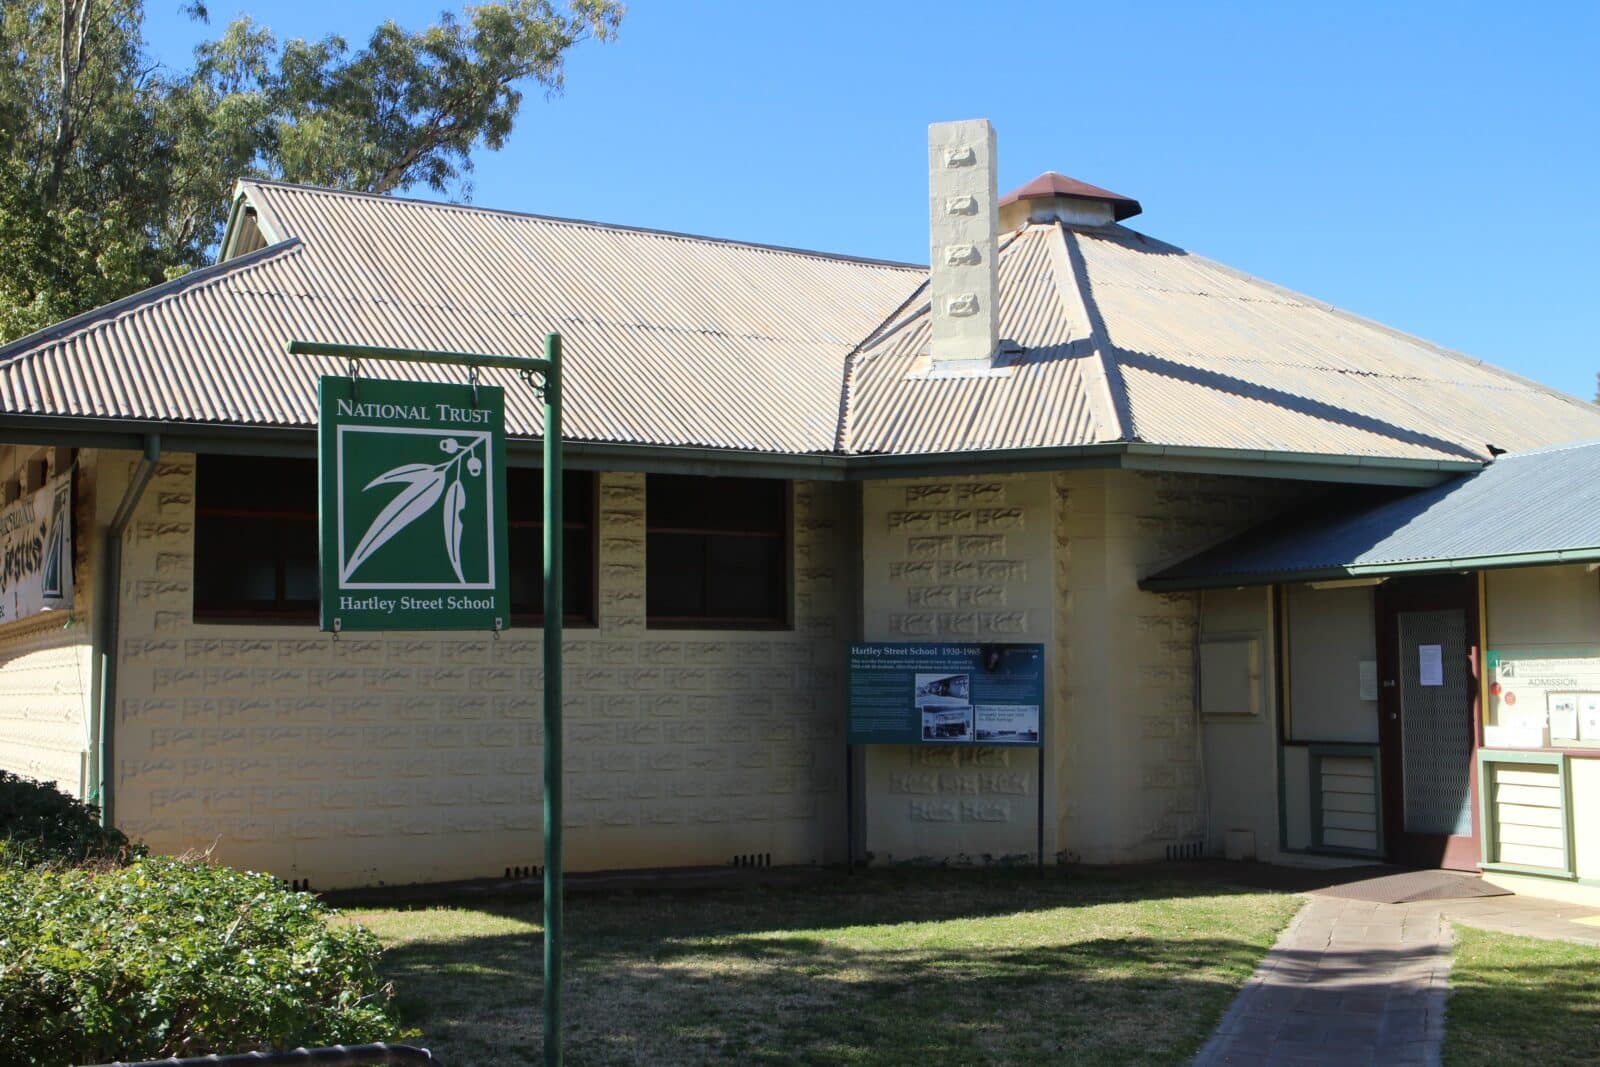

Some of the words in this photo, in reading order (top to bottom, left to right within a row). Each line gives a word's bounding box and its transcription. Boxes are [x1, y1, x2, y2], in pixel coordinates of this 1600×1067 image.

[336, 398, 430, 420] NATIONAL
[436, 404, 492, 423] TRUST
[339, 596, 396, 613] Hartley
[400, 596, 443, 610] Street
[447, 596, 495, 610] School
[851, 647, 881, 657] Hartley
[883, 647, 908, 656] Street
[910, 647, 937, 656] School
[1527, 679, 1578, 687] ADMISSION
